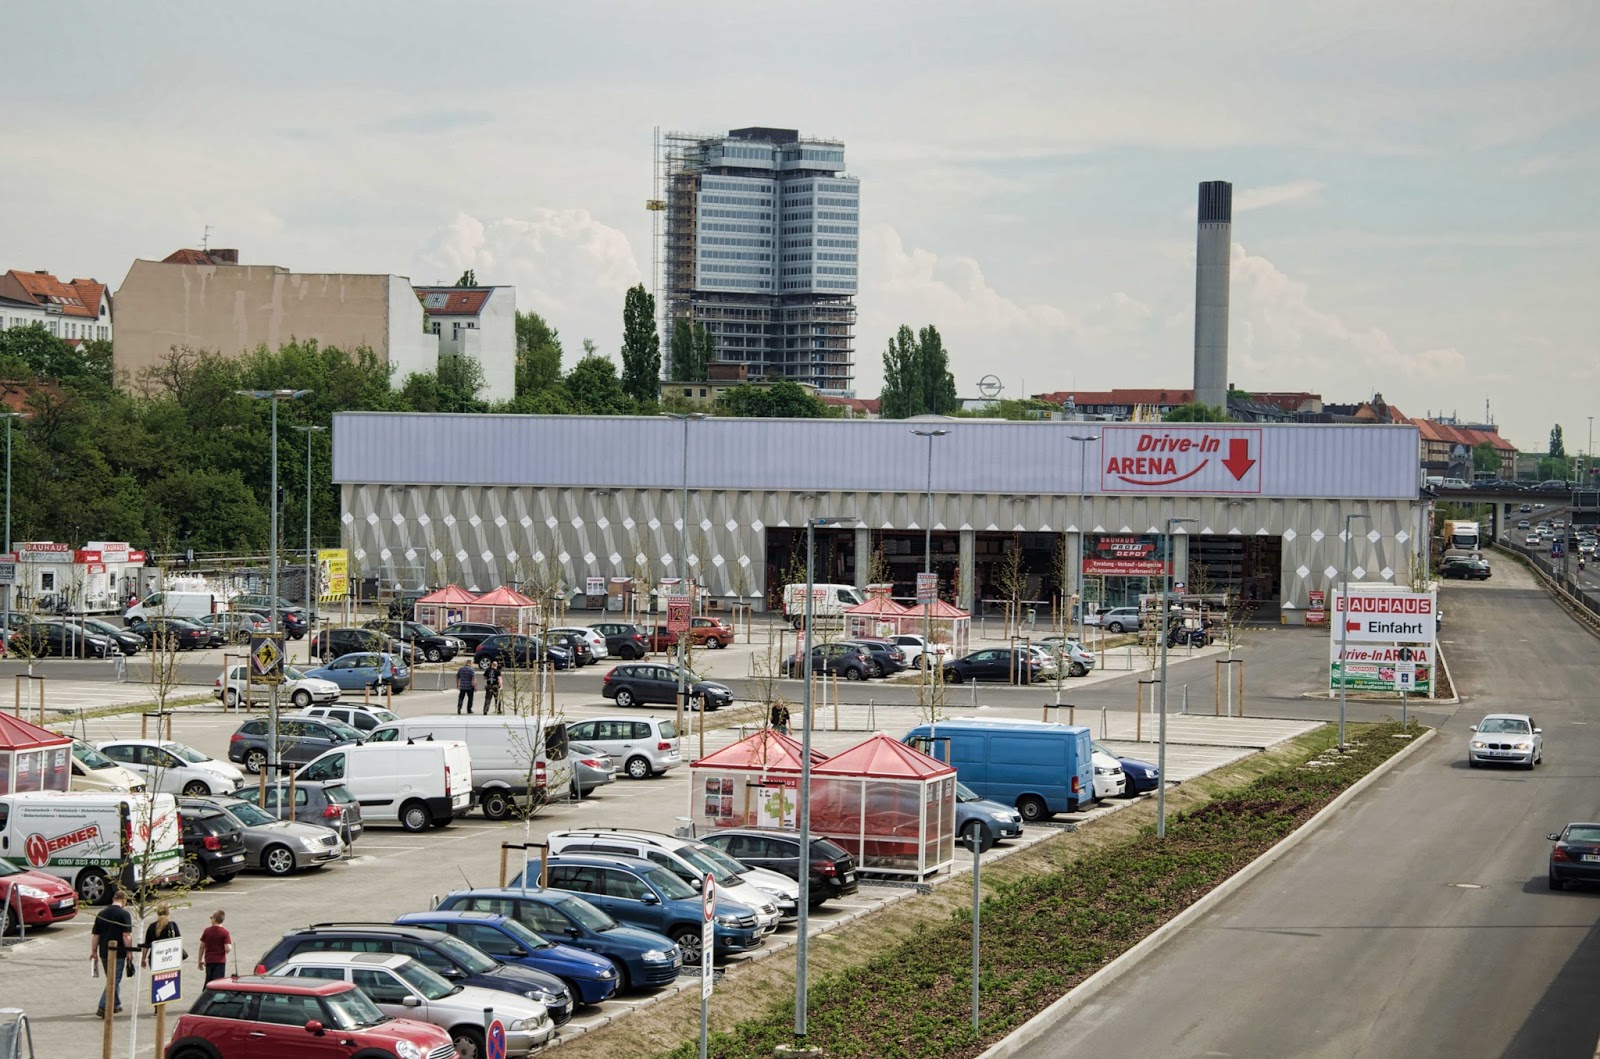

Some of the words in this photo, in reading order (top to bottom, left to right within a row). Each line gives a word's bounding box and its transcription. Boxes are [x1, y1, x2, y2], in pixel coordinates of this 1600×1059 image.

[1136, 434, 1220, 452] Drive-In
[1106, 457, 1177, 475] ARENA
[1336, 597, 1431, 614] BAUHAUS
[1368, 621, 1423, 634] Einfahrt
[1384, 649, 1427, 662] ARNA
[26, 826, 98, 867] WERNER
[154, 972, 178, 981] BAUHAUS
